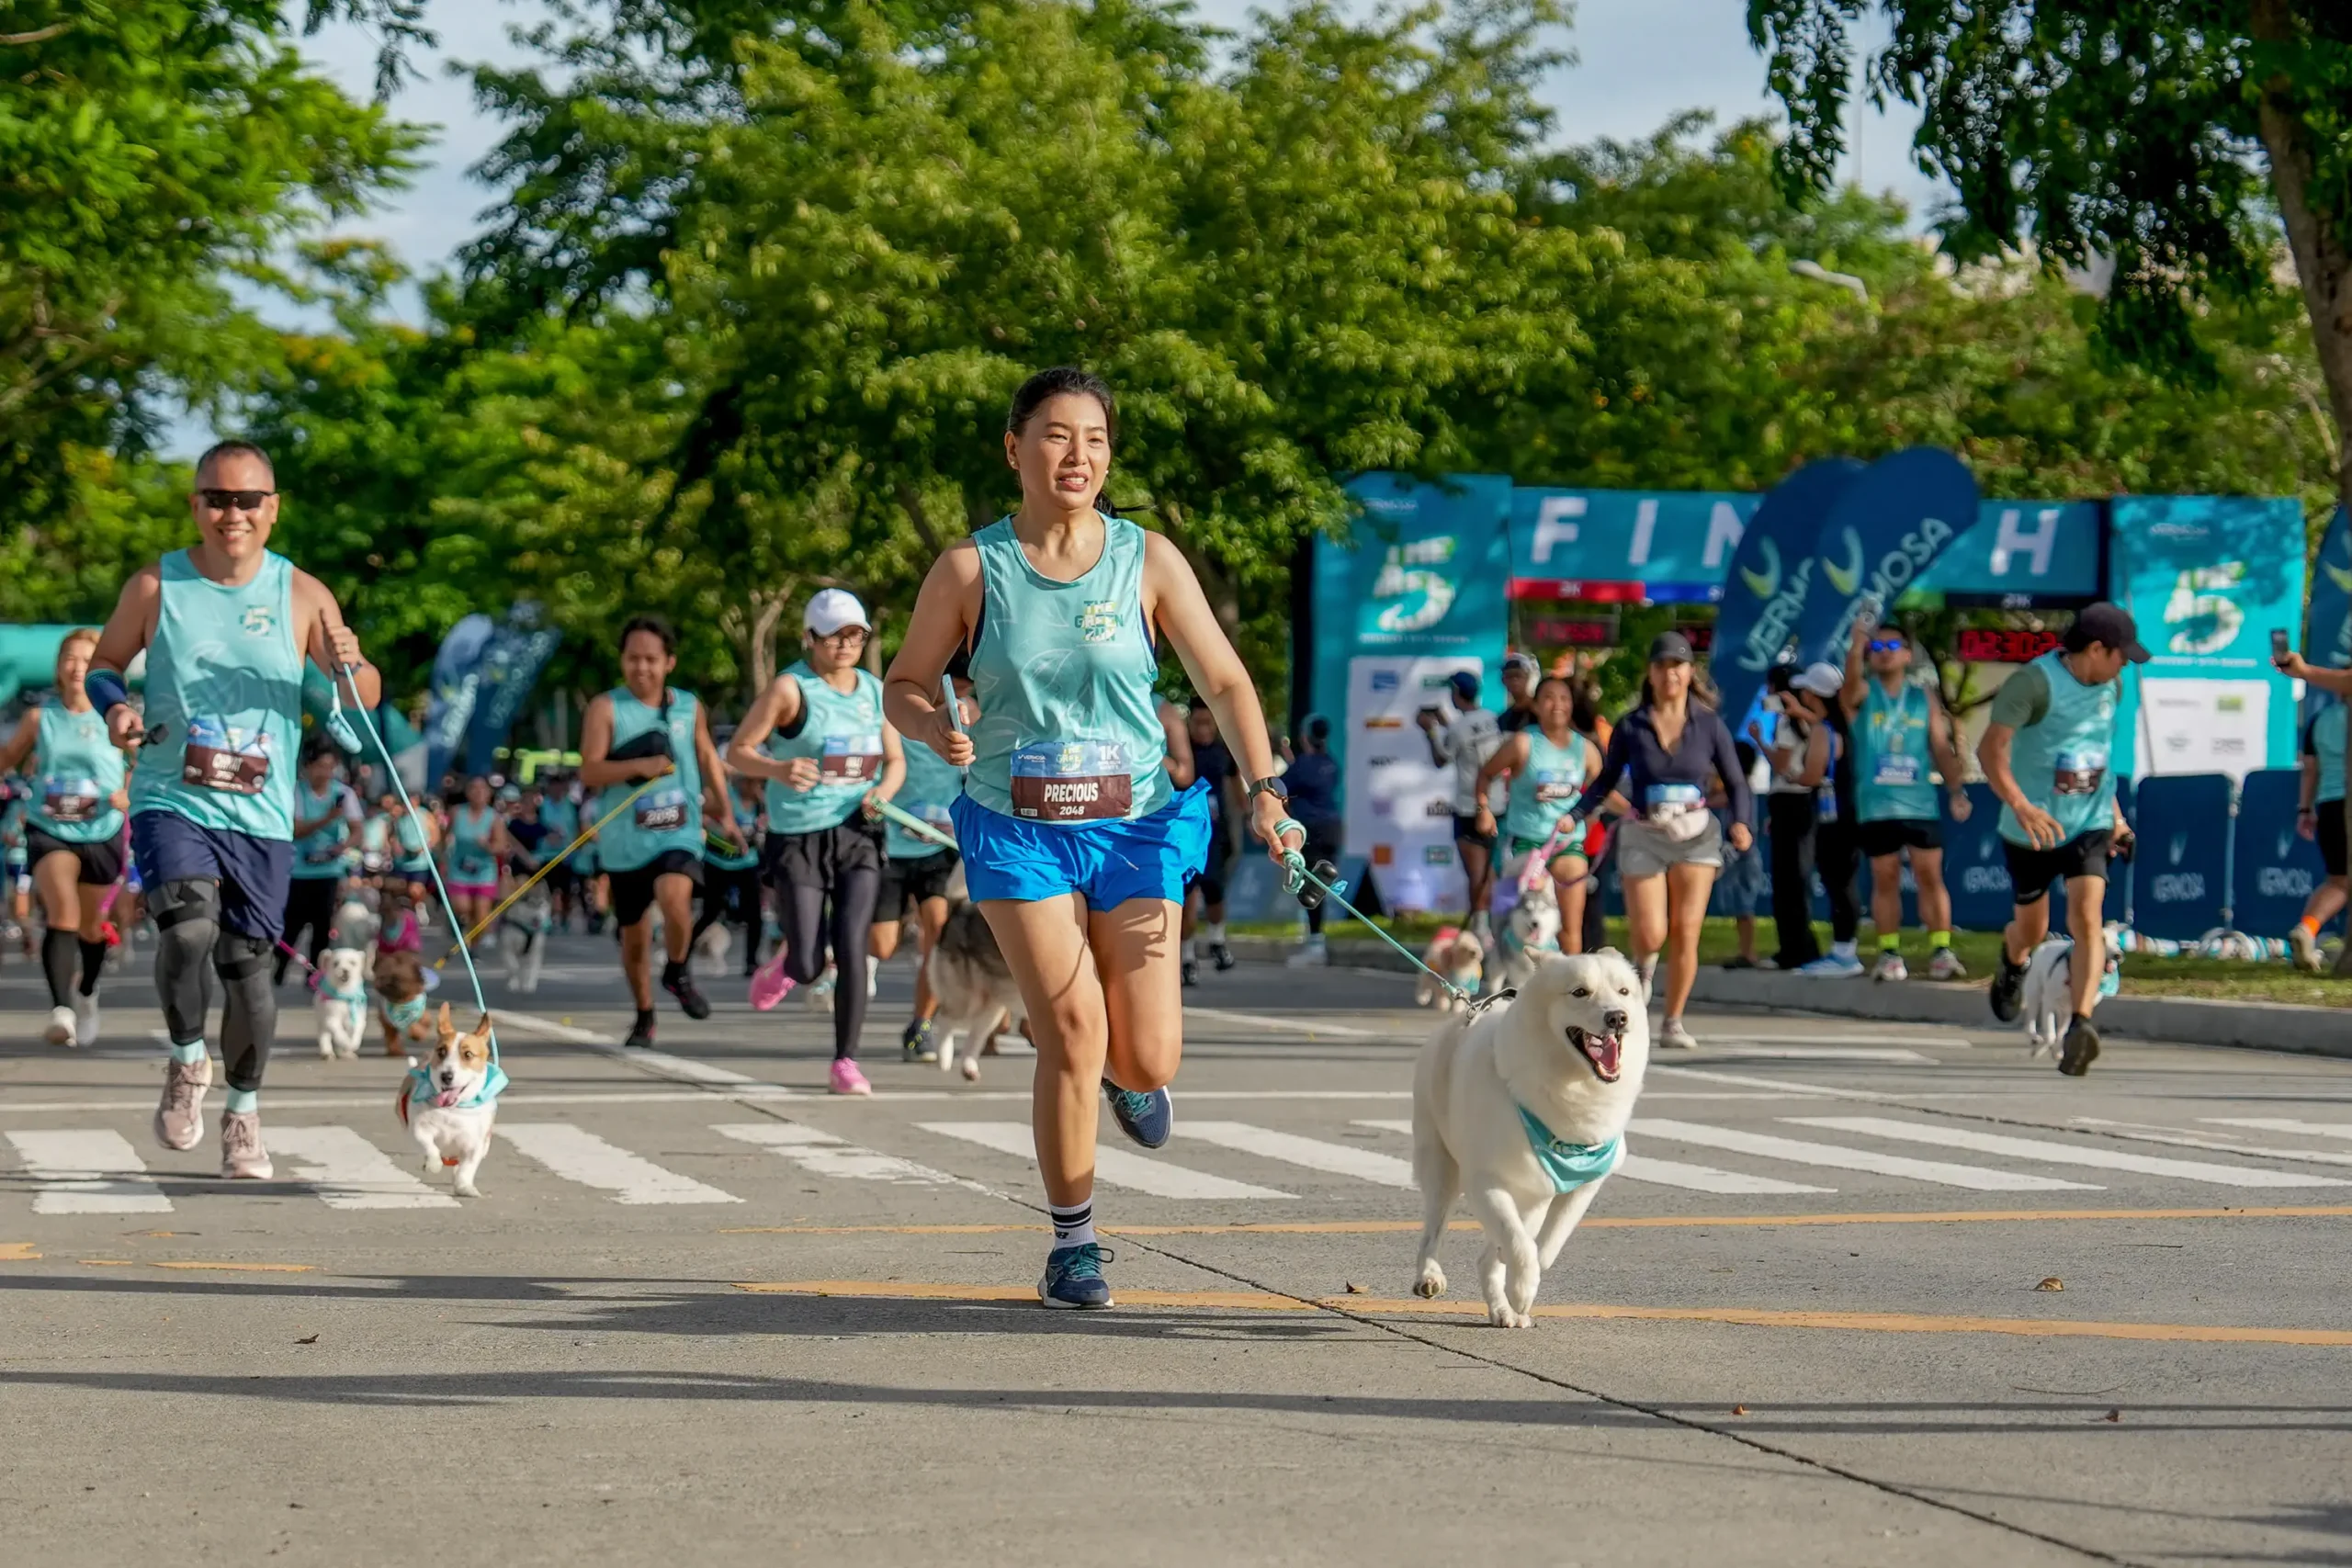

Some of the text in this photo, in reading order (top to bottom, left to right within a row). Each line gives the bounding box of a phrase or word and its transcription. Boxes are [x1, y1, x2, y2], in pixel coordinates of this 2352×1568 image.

[1961, 630, 2064, 662] 02:30:2
[1098, 745, 1120, 761] 1K
[1044, 783, 1099, 803] PRECIOUS
[1059, 806, 1085, 816] 2048
